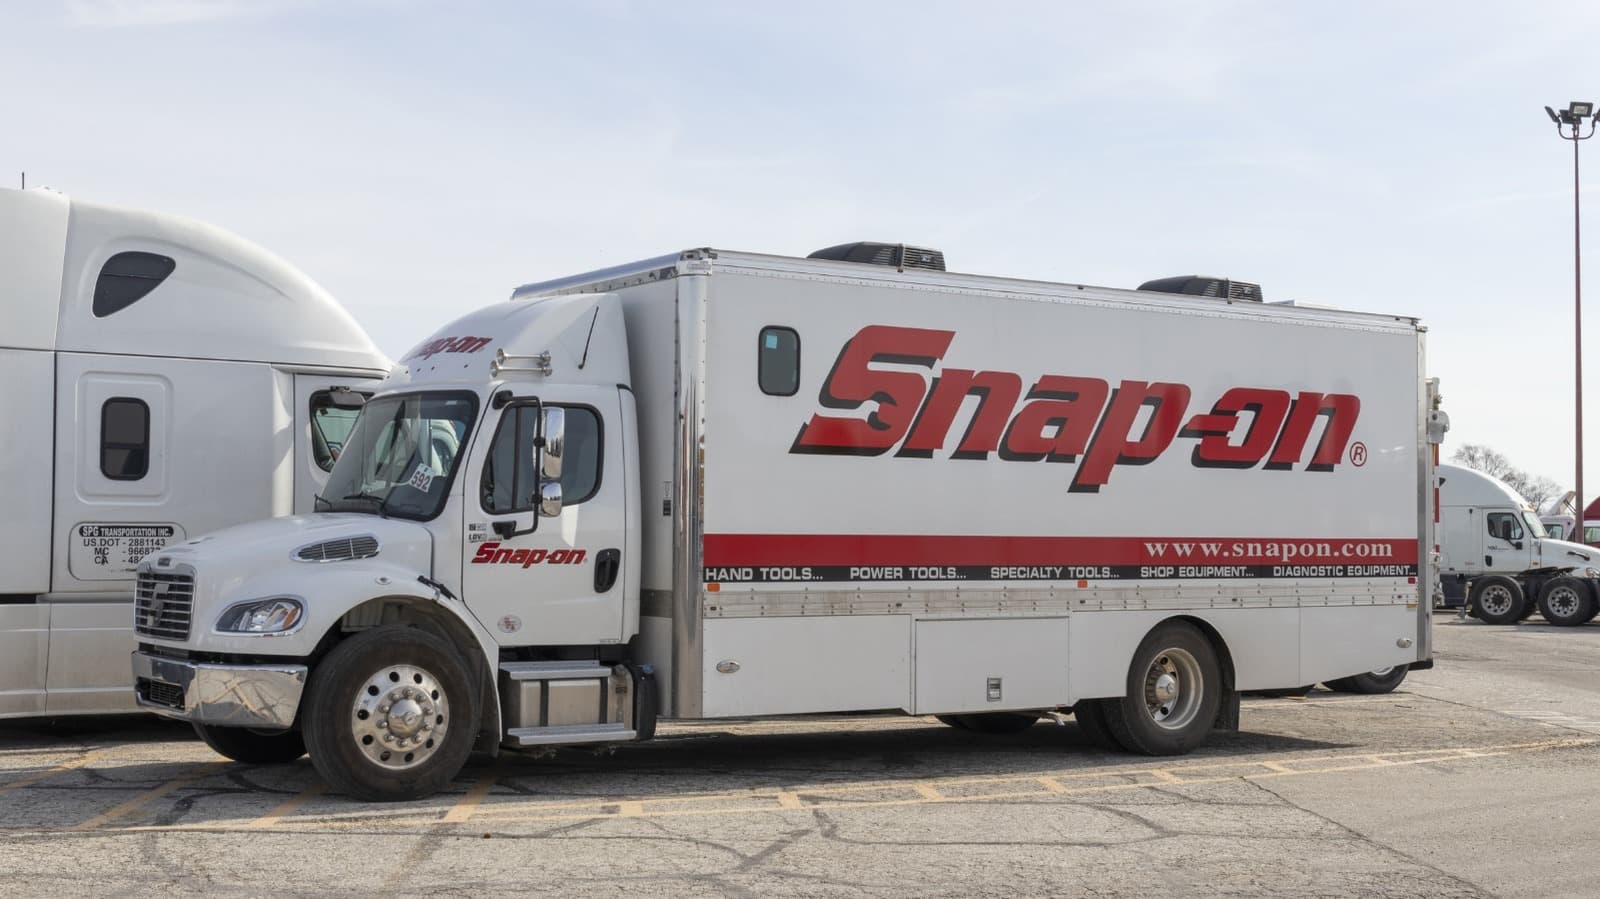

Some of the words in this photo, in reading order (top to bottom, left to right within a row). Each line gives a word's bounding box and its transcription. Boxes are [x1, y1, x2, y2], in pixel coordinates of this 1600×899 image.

[789, 324, 1361, 494] Snap-on
[411, 470, 430, 490] 592
[82, 526, 99, 537] SPG
[101, 527, 157, 537] TRANSPORTATION
[157, 527, 171, 537] INC.
[128, 538, 166, 547] 2881143
[94, 547, 109, 556] MC
[471, 542, 587, 569] Snap-on
[1144, 542, 1393, 562] www.snapon.com
[94, 556, 109, 565] CA
[705, 567, 754, 581] HAND
[759, 567, 824, 581] TOOLS...
[850, 567, 903, 580] POWER
[909, 567, 967, 580] TOOLS...
[990, 567, 1062, 579] SPECIALTY
[1068, 567, 1120, 579] TOOLS...
[1140, 566, 1175, 578] SHOP
[1179, 566, 1254, 578] EQUIPMENT...
[1273, 566, 1344, 577] DIAGNOSTIC
[1347, 565, 1417, 577] EQUIPMENT...
